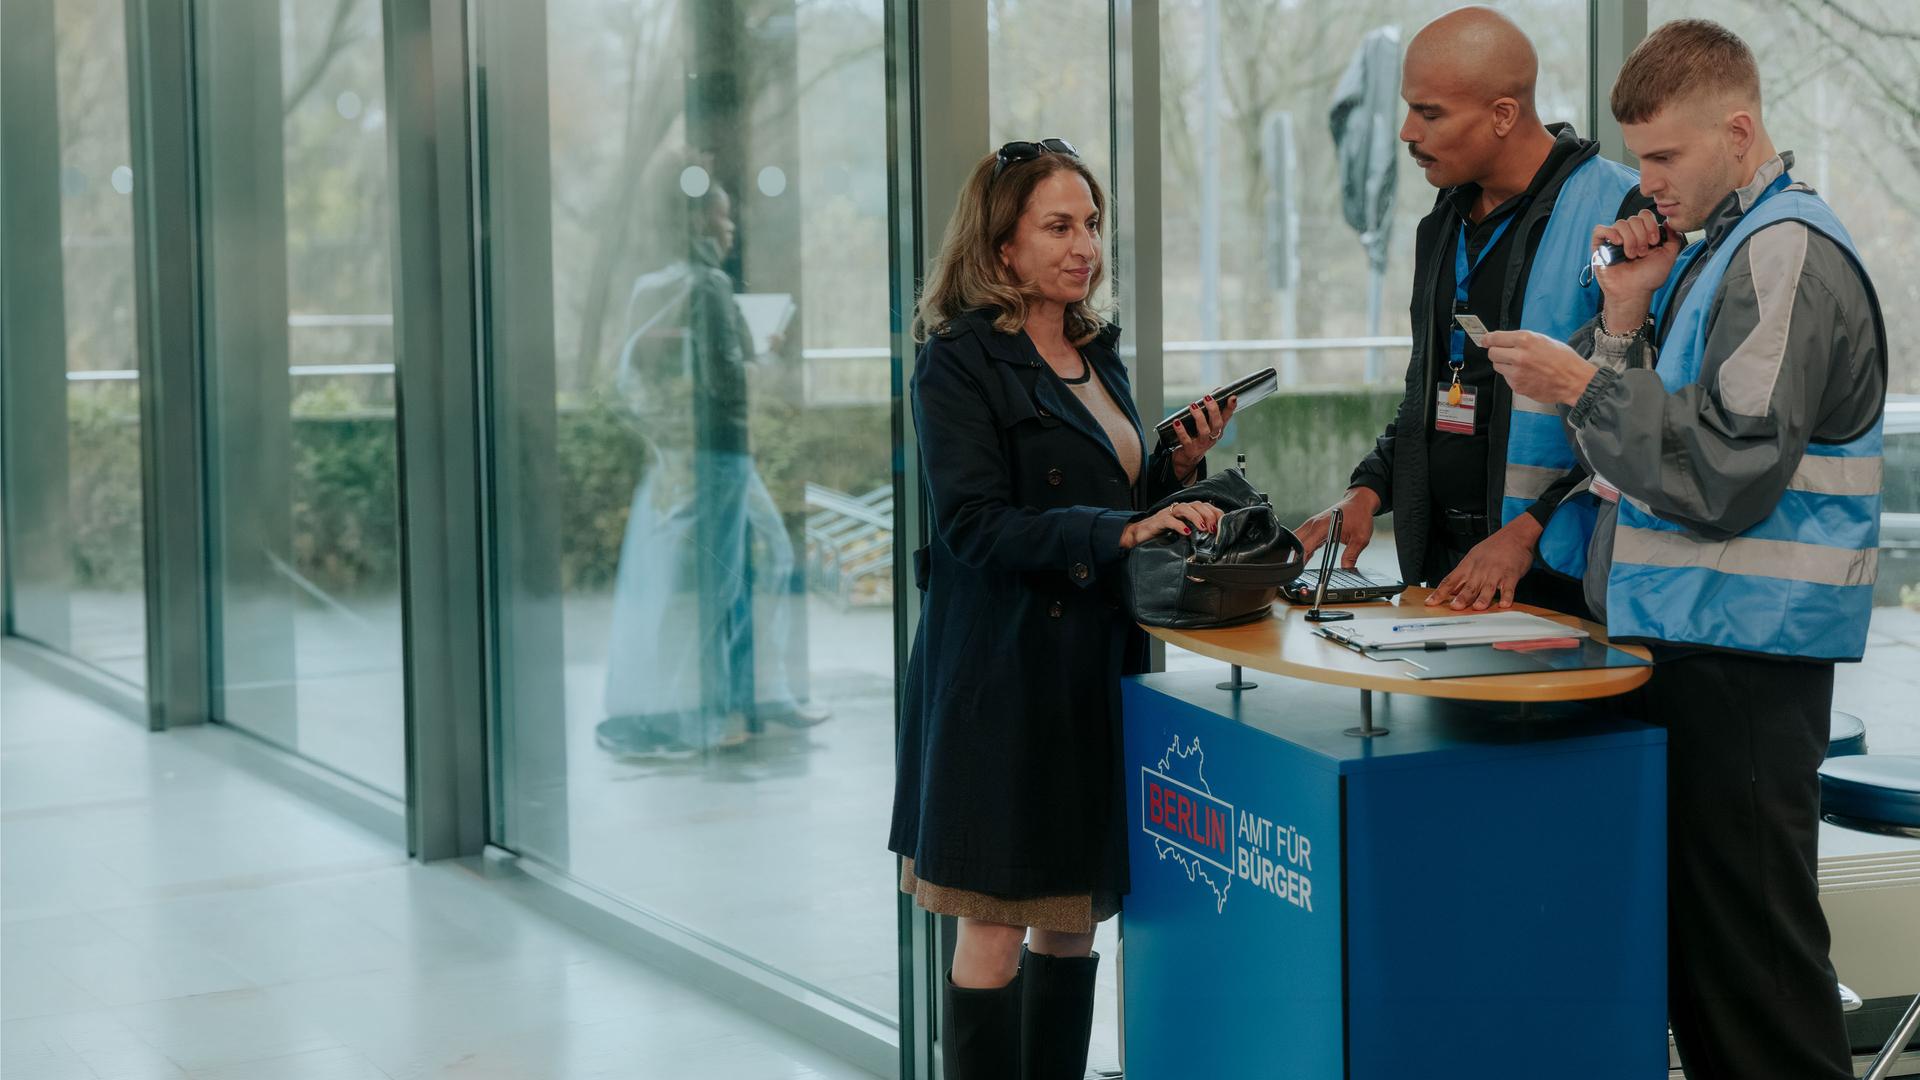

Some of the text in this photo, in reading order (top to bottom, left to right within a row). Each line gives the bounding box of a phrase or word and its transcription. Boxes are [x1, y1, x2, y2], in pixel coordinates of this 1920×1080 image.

[1150, 784, 1225, 853] BERLIN
[1239, 810, 1312, 871] AMT FÜR
[1239, 846, 1312, 912] BÜRGER
